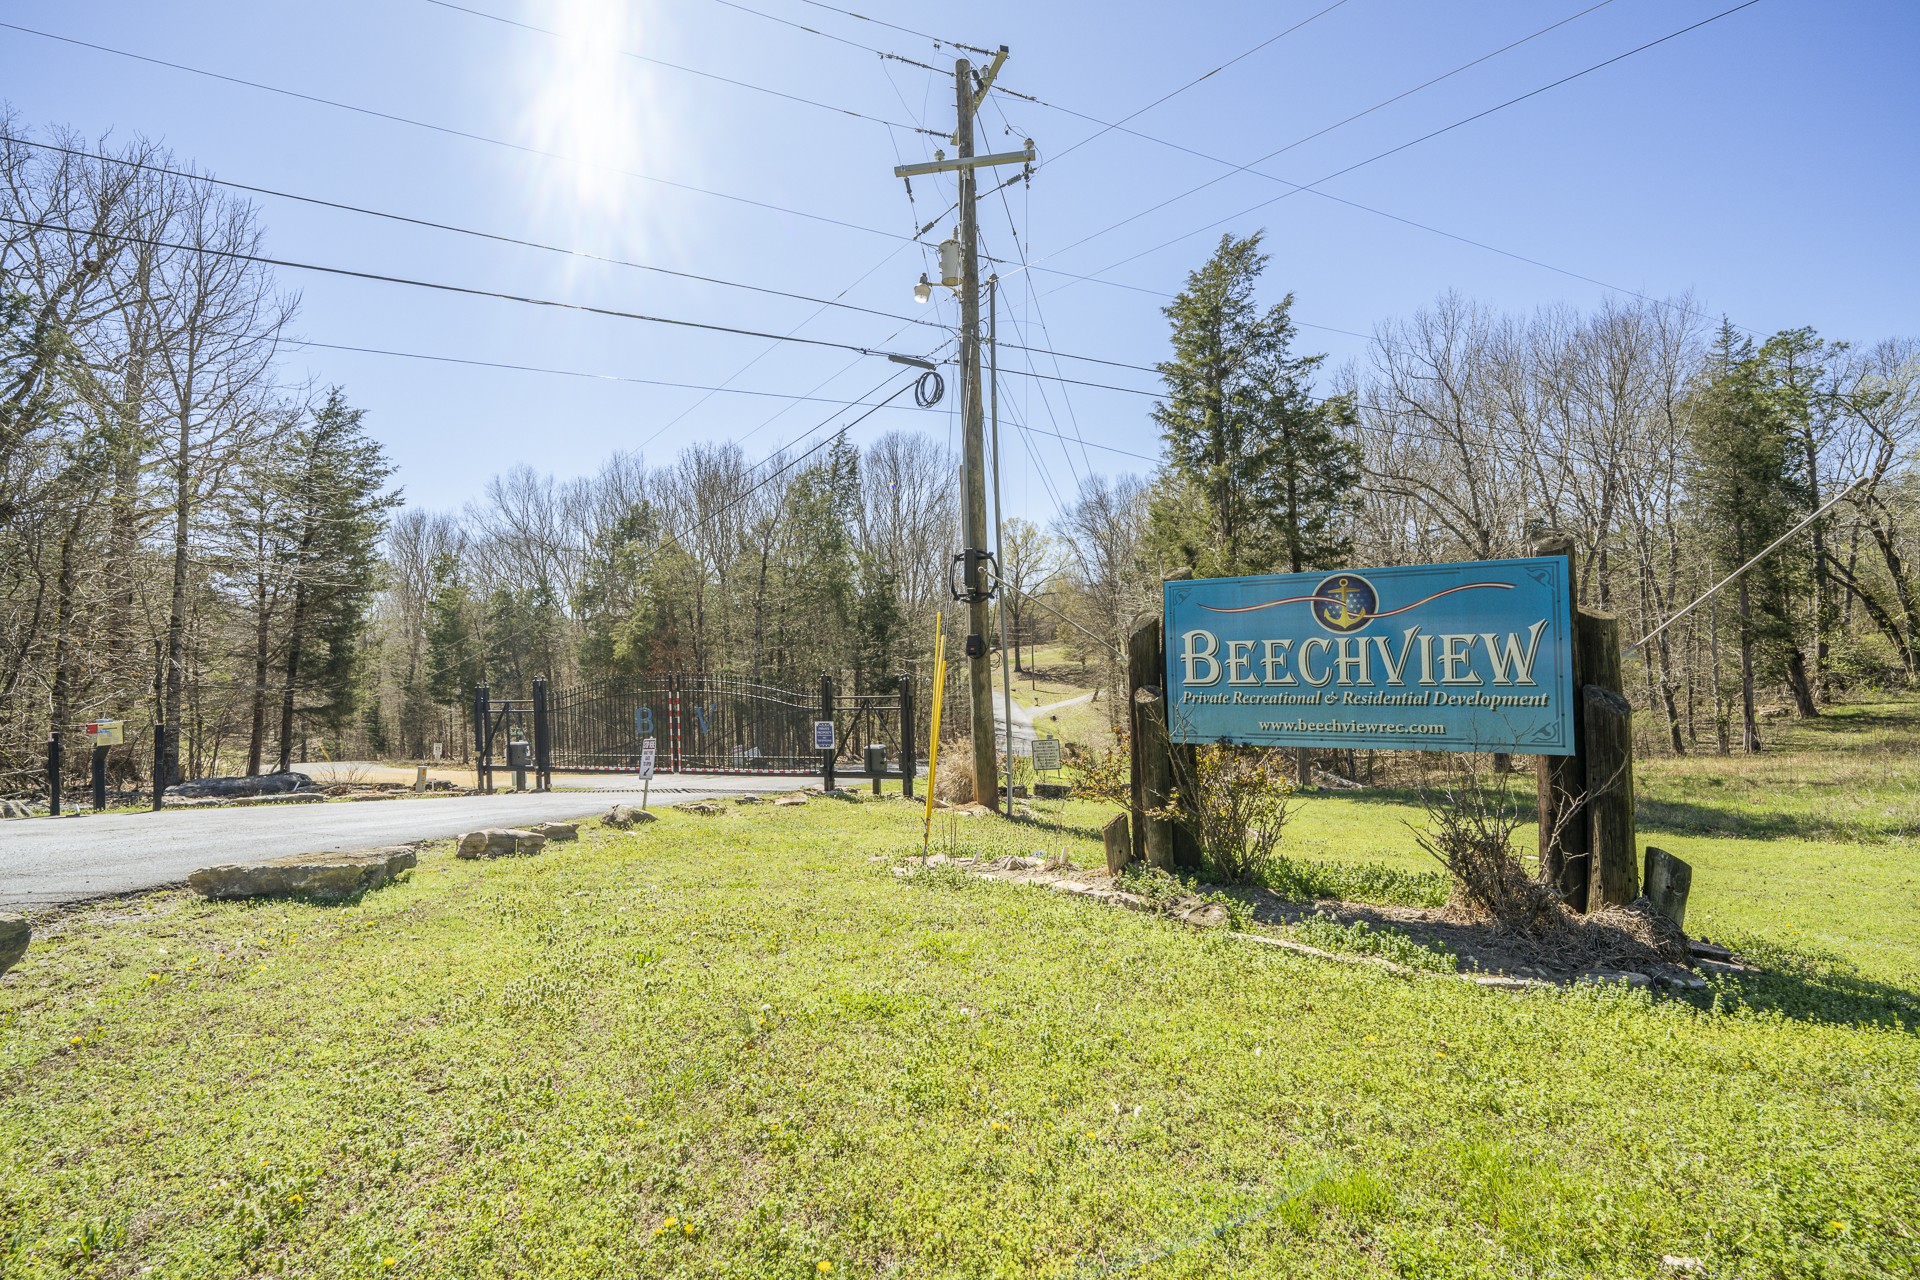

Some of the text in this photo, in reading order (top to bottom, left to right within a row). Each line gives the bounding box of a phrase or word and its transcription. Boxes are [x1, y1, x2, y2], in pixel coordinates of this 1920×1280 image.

[1180, 618, 1549, 687] BEECHVIEW
[1182, 690, 1549, 710] Private Recreational & Residential Development
[636, 703, 716, 734] B V
[1258, 718, 1446, 734] www.beechviewrec.com
